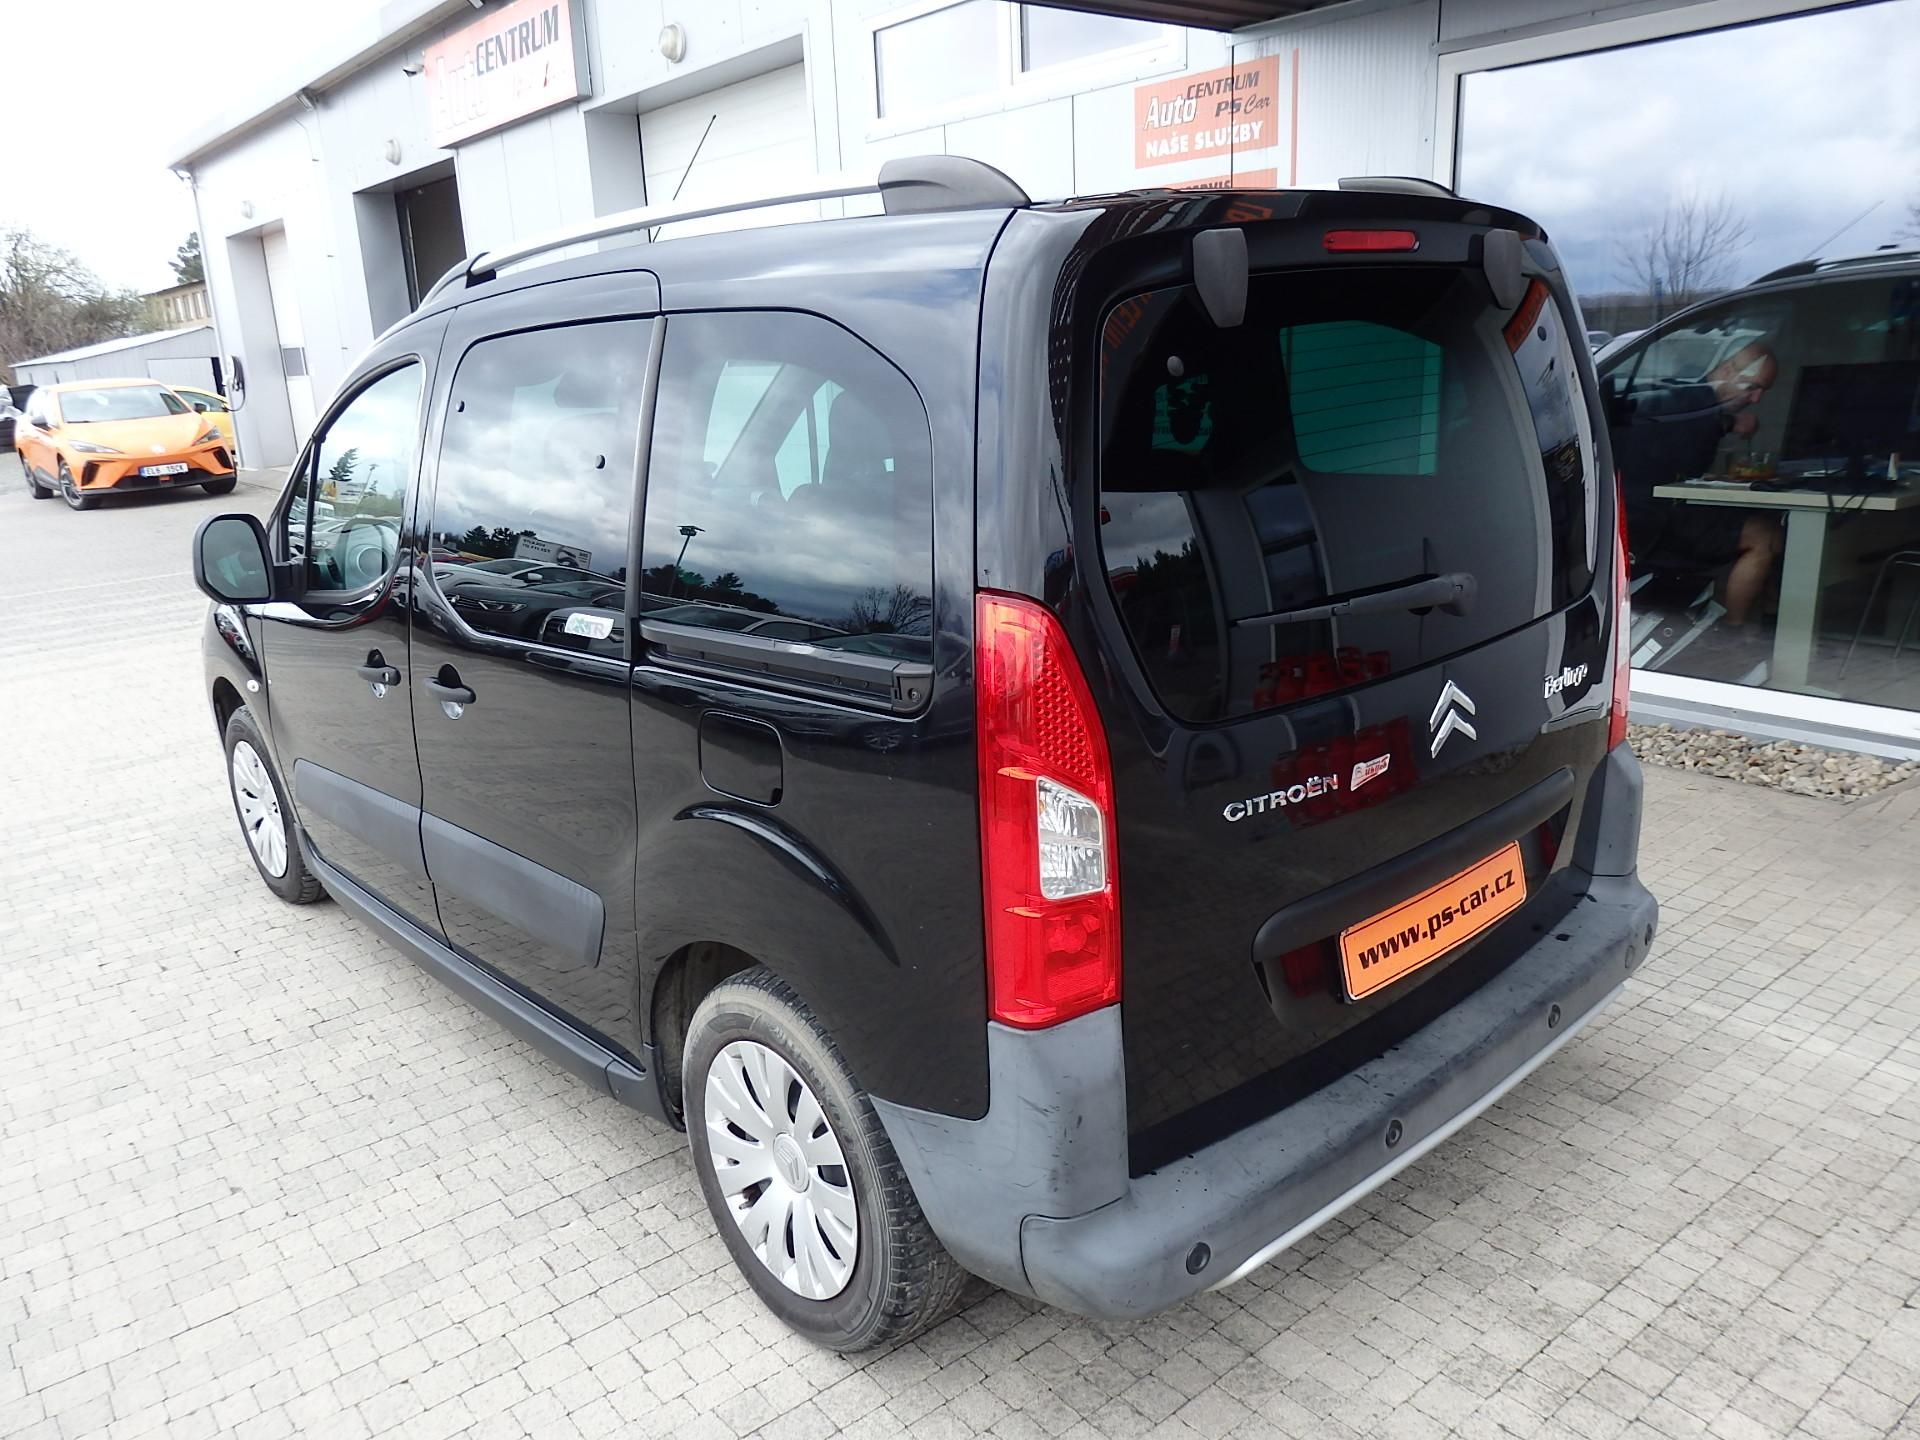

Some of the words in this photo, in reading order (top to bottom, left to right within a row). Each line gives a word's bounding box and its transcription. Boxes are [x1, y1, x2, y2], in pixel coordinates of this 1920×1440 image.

[476, 4, 559, 76] CENTRUM
[1186, 71, 1260, 100] CENTRUM
[1144, 95, 1198, 130] Auto
[1215, 97, 1243, 117] PS
[1243, 94, 1271, 115] Car
[1145, 131, 1189, 159] NAŠE
[1194, 120, 1264, 151] SLUŽBY
[1543, 662, 1588, 699] Berlingo
[1222, 774, 1339, 822] CITROËN
[1358, 869, 1516, 970] www.ps-car.cz
